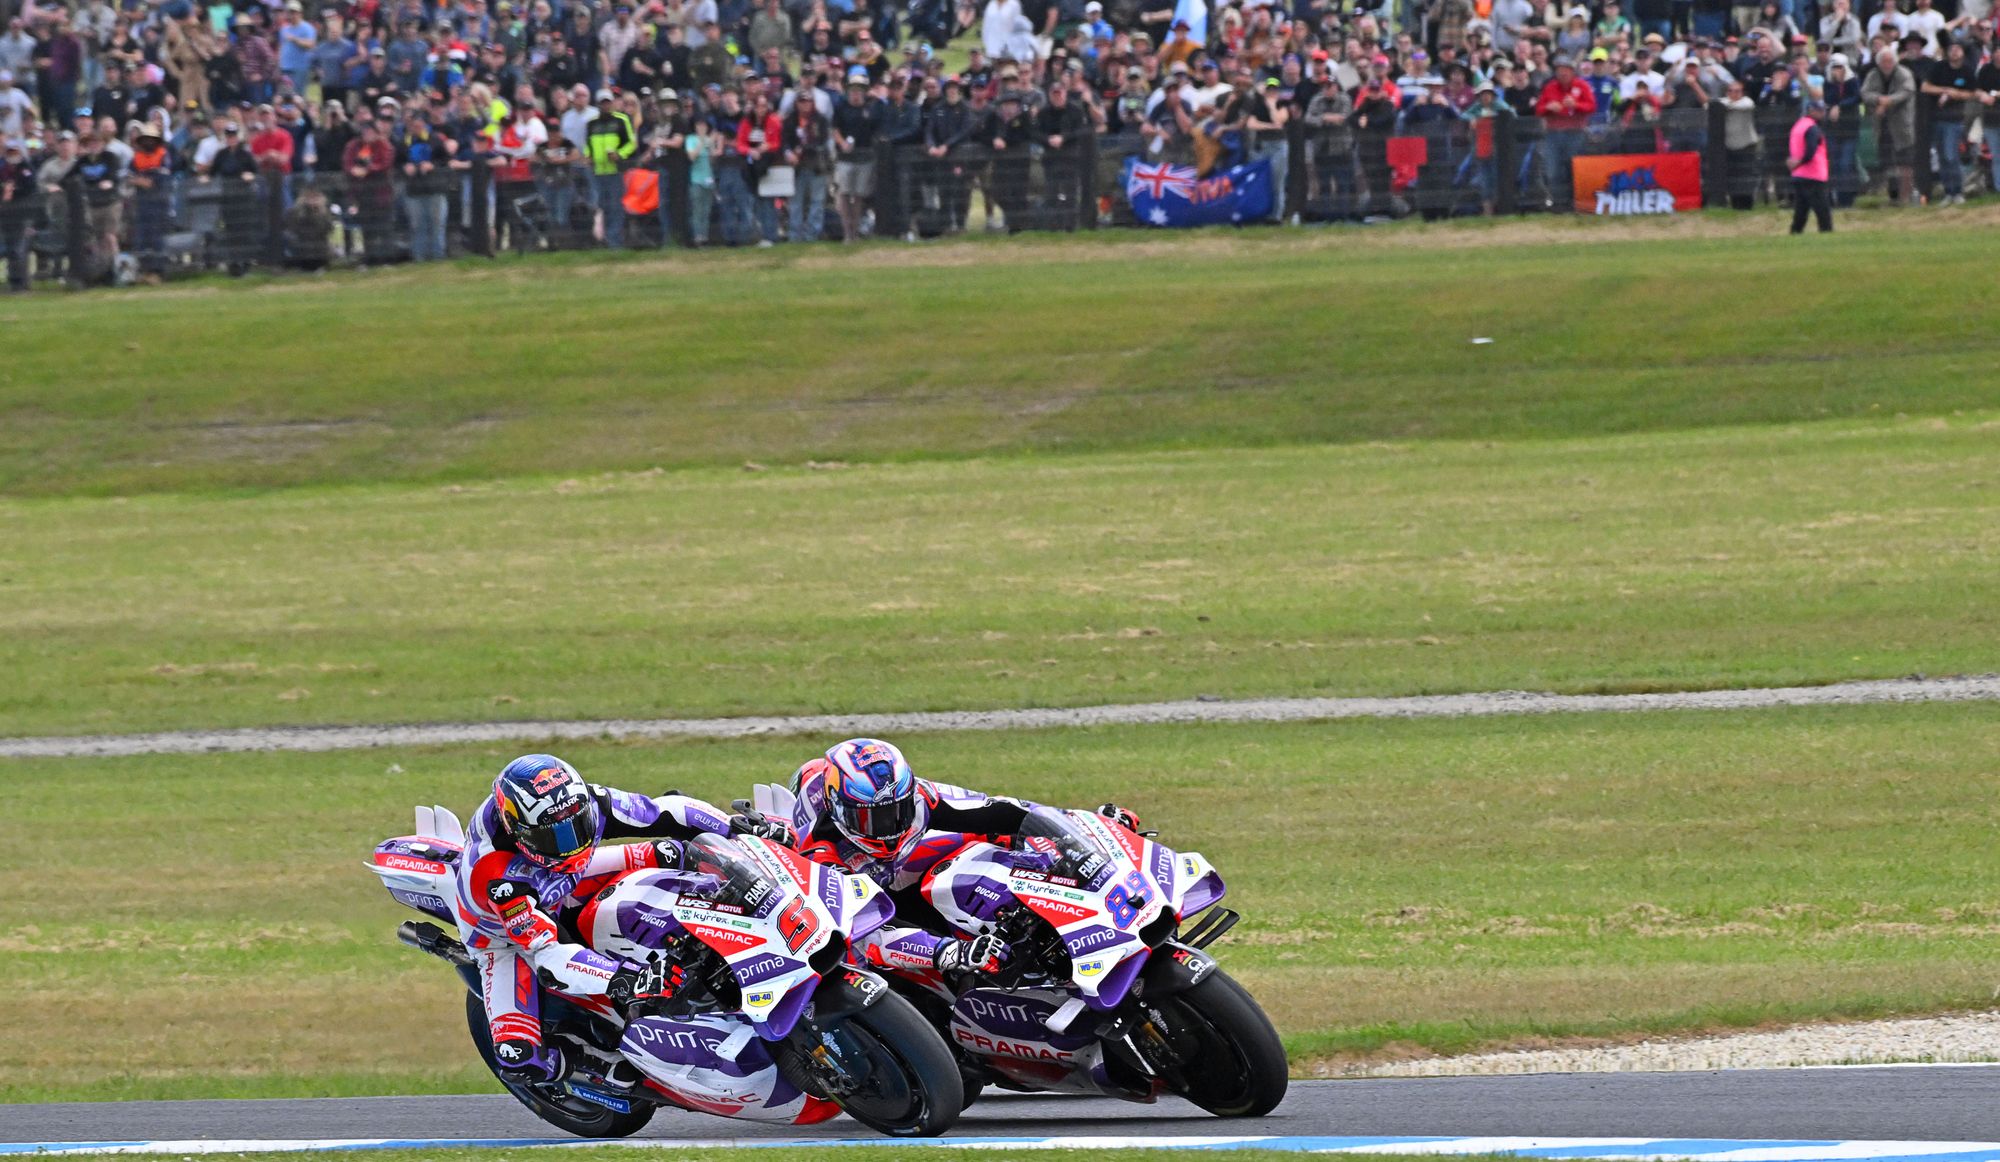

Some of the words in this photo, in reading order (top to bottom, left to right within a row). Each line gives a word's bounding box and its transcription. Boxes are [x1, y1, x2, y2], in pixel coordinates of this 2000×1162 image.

[546, 795, 580, 815] SHARK
[1105, 820, 1140, 861] PRAMAC
[392, 858, 439, 873] PRAMAC
[770, 844, 808, 885] PRAMAC
[1157, 847, 1171, 885] prima
[1012, 869, 1048, 881] WRS
[1050, 876, 1077, 887] MOTUL
[1091, 862, 1117, 889] prima
[826, 868, 840, 909] prima
[974, 885, 1001, 902] DUCATI
[405, 893, 444, 908] prima
[678, 898, 713, 909] WRS
[716, 904, 743, 914] MOTUL
[759, 889, 783, 915] prima
[1028, 898, 1085, 917] PRAMAC
[1104, 870, 1155, 931] 89
[505, 910, 531, 929] MOTUL
[640, 913, 667, 929] DUCATI
[776, 893, 820, 956] 5
[695, 926, 754, 945] PRAMAC
[1068, 929, 1116, 955] prima
[900, 942, 934, 956] prima
[586, 954, 614, 967] prima
[889, 952, 934, 967] PRAMA
[566, 963, 612, 981] PRAMAC
[736, 956, 785, 984] prima
[484, 951, 495, 1017] PRAMAC
[963, 997, 1051, 1025] prima
[631, 1023, 723, 1052] prima
[955, 1028, 1077, 1066] PRAMAC
[582, 1092, 624, 1110] MICHELIN
